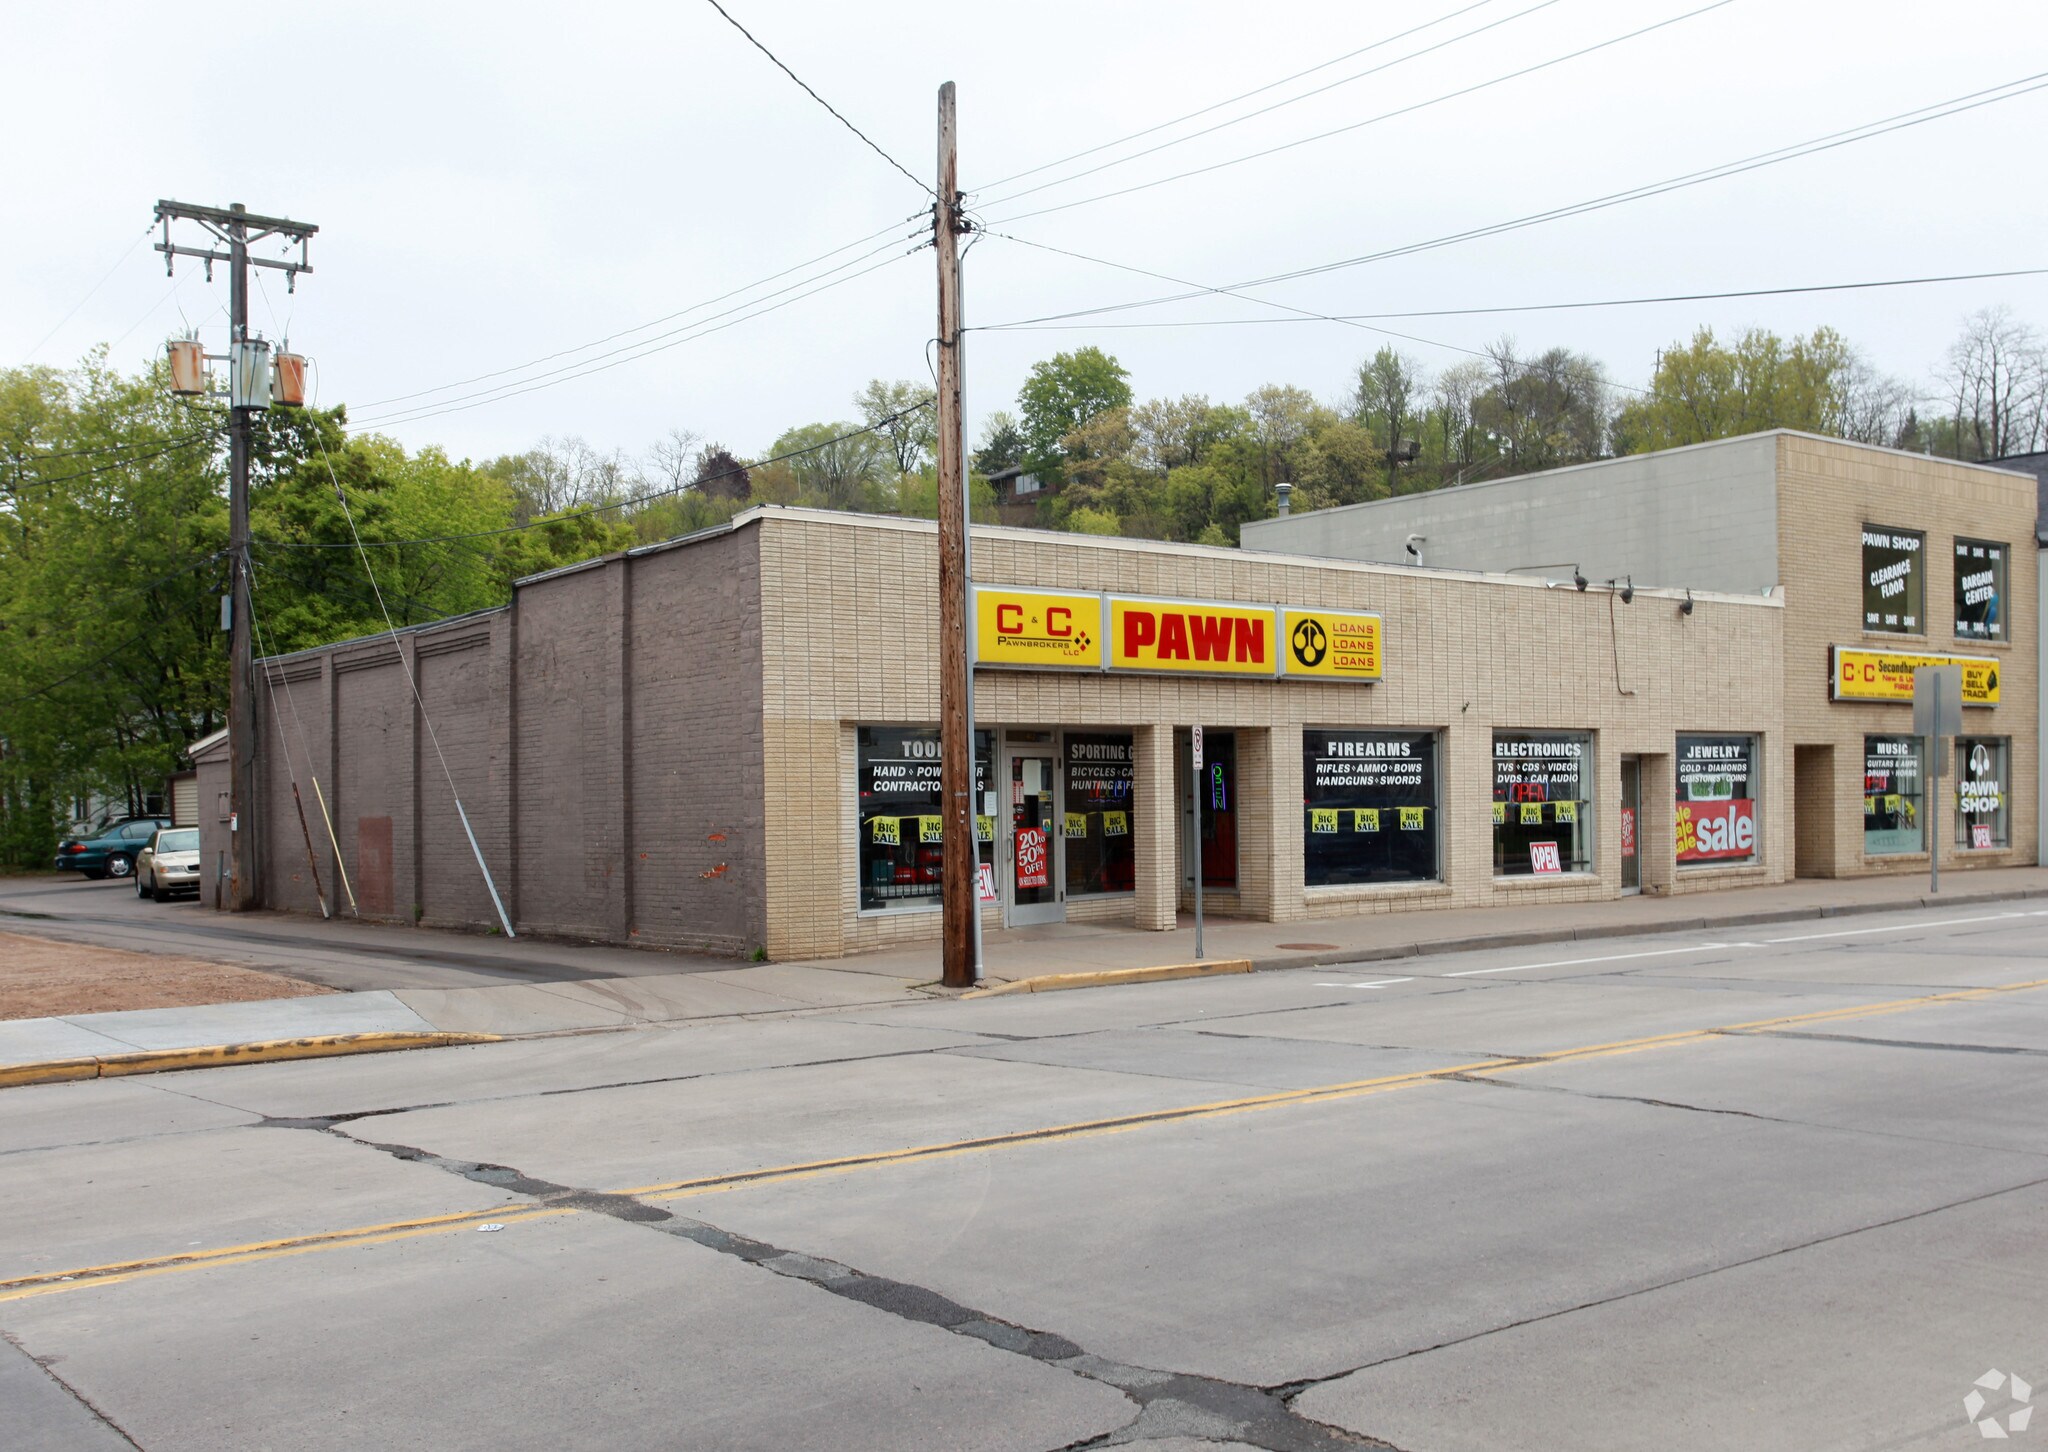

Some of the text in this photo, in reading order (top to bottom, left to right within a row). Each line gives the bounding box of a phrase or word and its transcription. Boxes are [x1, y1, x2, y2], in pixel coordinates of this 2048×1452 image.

[1862, 532, 1920, 551] PAWN SHOP
[1956, 545, 2000, 560] SAVE SAVE SAVE
[1870, 558, 1911, 587] CLEARANCE
[1962, 570, 1993, 591] BARGAIN
[1881, 578, 1904, 599] FLOOR
[1965, 586, 1994, 606] CENTER
[997, 604, 1023, 634] C
[1046, 607, 1072, 636] C
[1867, 613, 1915, 626] SAVE SAVE SAVE
[1332, 623, 1374, 634] LOANS
[1956, 621, 2000, 633] SAVE SAVE SAVE
[1123, 610, 1264, 664] PAWN
[1333, 640, 1374, 650] LOANS
[1333, 656, 1374, 666] LOANS
[1843, 663, 1854, 681] C
[1864, 664, 1875, 682] C
[1967, 670, 1983, 678] BUY
[1962, 690, 1988, 698] TRADE
[1071, 744, 1124, 760] SPORTING
[1328, 742, 1411, 756] FIREARMS
[1496, 743, 1581, 757] ELECTRONICS
[1687, 746, 1740, 758] JEWELRY
[1877, 743, 1908, 754] MUSIC
[1316, 764, 1422, 773] RIFLES AMMO BOWS
[1498, 763, 1578, 772] TVS CDS VIDEOS
[1680, 764, 1747, 772] GOLD DIAMONDS
[1867, 760, 1894, 768] GUITARS
[873, 766, 942, 777] HAND POW
[1071, 767, 1133, 777] BICYCLES CA
[1316, 776, 1421, 786] HANDGUNS SWORDS
[1497, 774, 1578, 783] DVDS CAR AUDIO
[1680, 774, 1746, 783] GEMSTONES COINS
[873, 781, 942, 792] CONTRACTO
[1071, 780, 1114, 790] HUNTING
[1117, 781, 1123, 790] &
[1961, 781, 1998, 795] PAWN
[1511, 783, 1545, 802] OPEN
[1961, 798, 1999, 813] SHOP
[1318, 815, 1332, 823] BIG
[1360, 814, 1374, 822] BIG
[1676, 806, 1691, 822] ale
[927, 822, 941, 831] BIG
[1109, 817, 1121, 826] BIG
[1357, 822, 1377, 831] SALE
[1402, 821, 1422, 829] SALE
[878, 822, 895, 833] BIG
[1066, 828, 1085, 837] SALE
[1106, 825, 1125, 834] SALE
[1314, 824, 1336, 832] SALE
[1676, 820, 1693, 838] ale
[1697, 805, 1753, 853] sale
[873, 833, 898, 844] SALE
[978, 831, 991, 840] ALE
[1019, 830, 1046, 849] 20 to
[1973, 828, 1990, 847] OPEN
[1018, 844, 1044, 867] 50%
[1532, 846, 1560, 870] OPEN
[1025, 860, 1044, 875] OFF!
